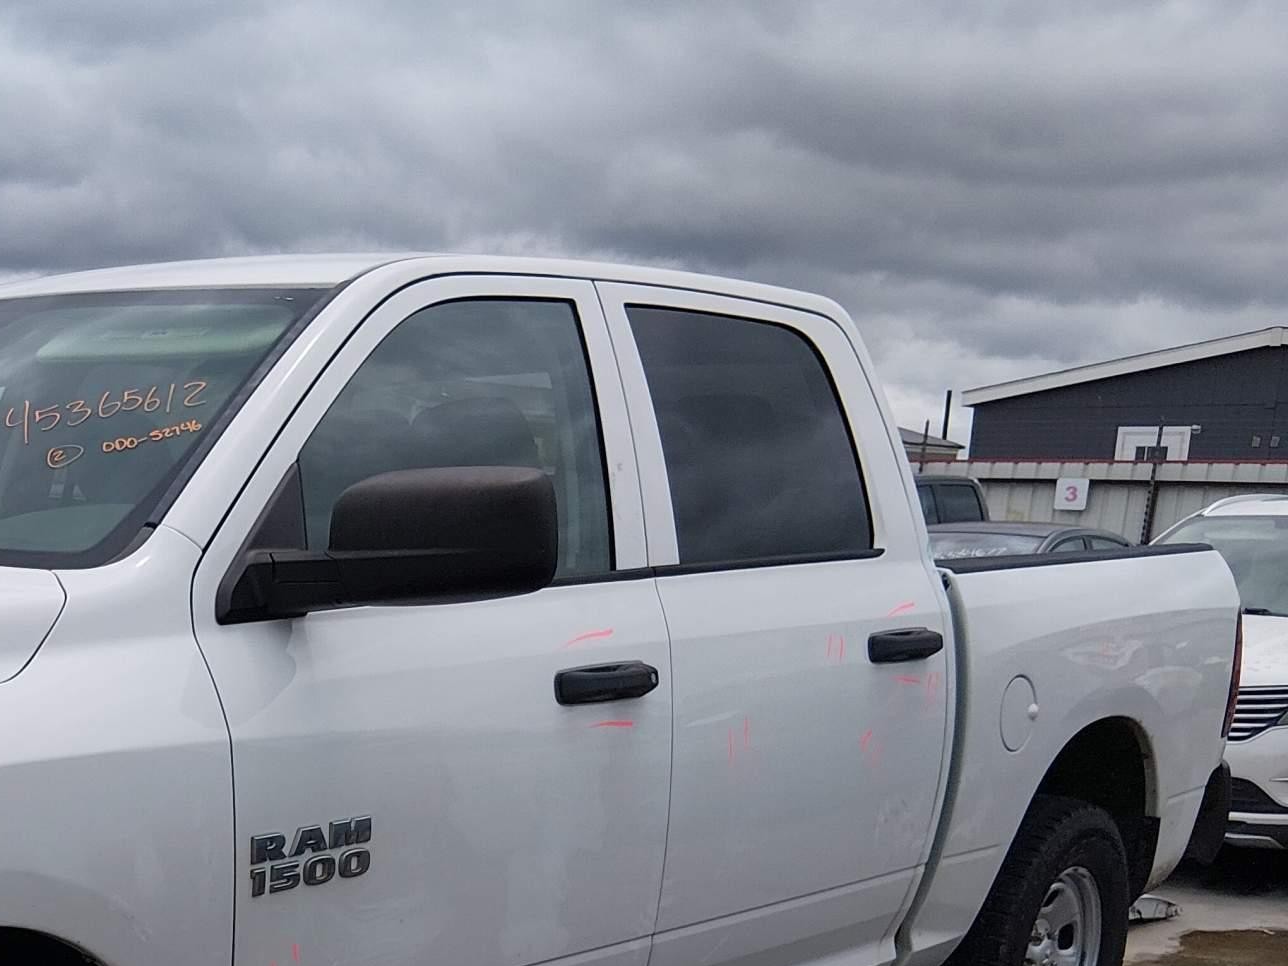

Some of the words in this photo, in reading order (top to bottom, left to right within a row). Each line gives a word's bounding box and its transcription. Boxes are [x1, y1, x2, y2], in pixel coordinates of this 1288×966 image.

[5, 381, 208, 444] 45365612
[1064, 485, 1079, 502] 3
[250, 815, 373, 865] RAM
[250, 847, 371, 898] 1500
